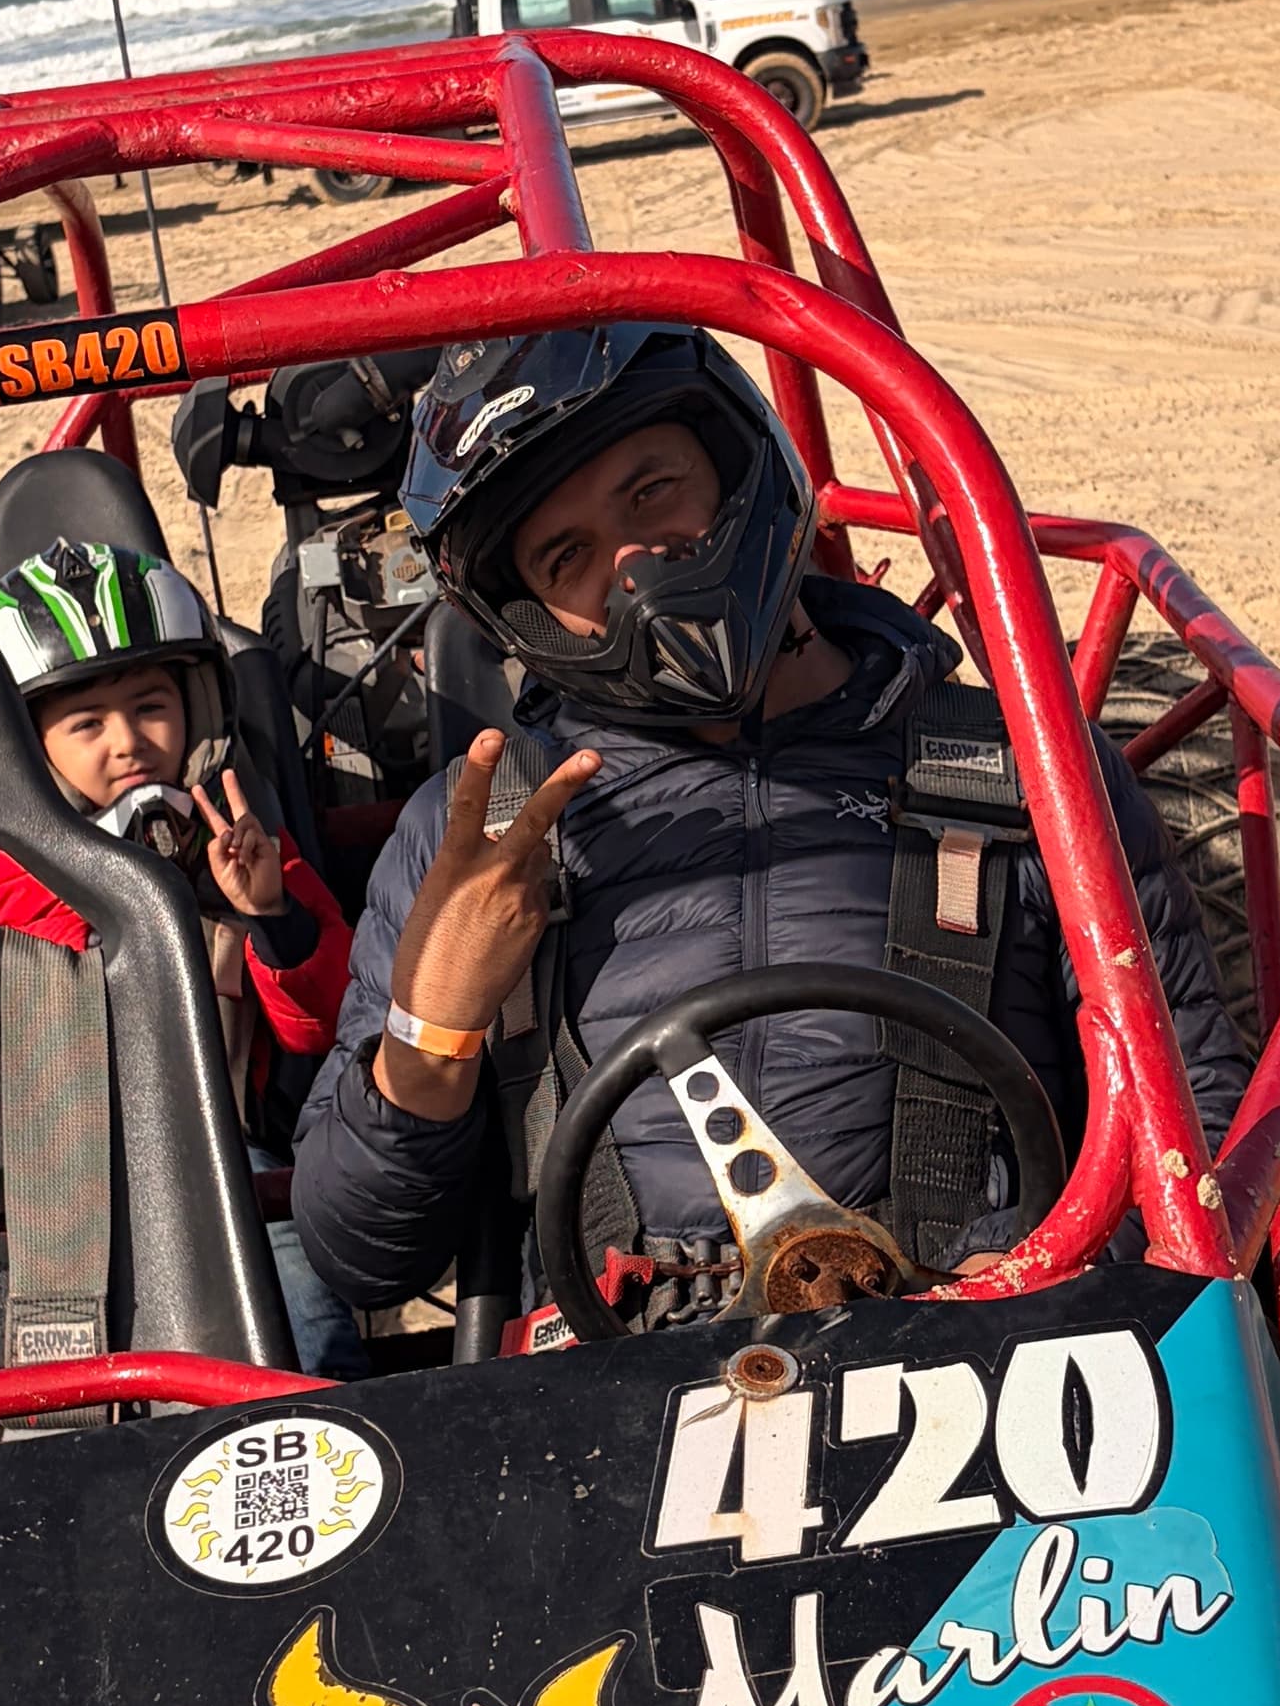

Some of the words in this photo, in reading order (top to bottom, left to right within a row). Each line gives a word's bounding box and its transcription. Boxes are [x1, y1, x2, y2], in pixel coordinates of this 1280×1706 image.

[926, 740, 979, 758] CROW
[22, 1329, 73, 1350] CROW
[235, 1430, 308, 1468] SB
[653, 1328, 1160, 1562] 420
[223, 1524, 315, 1568] 420
